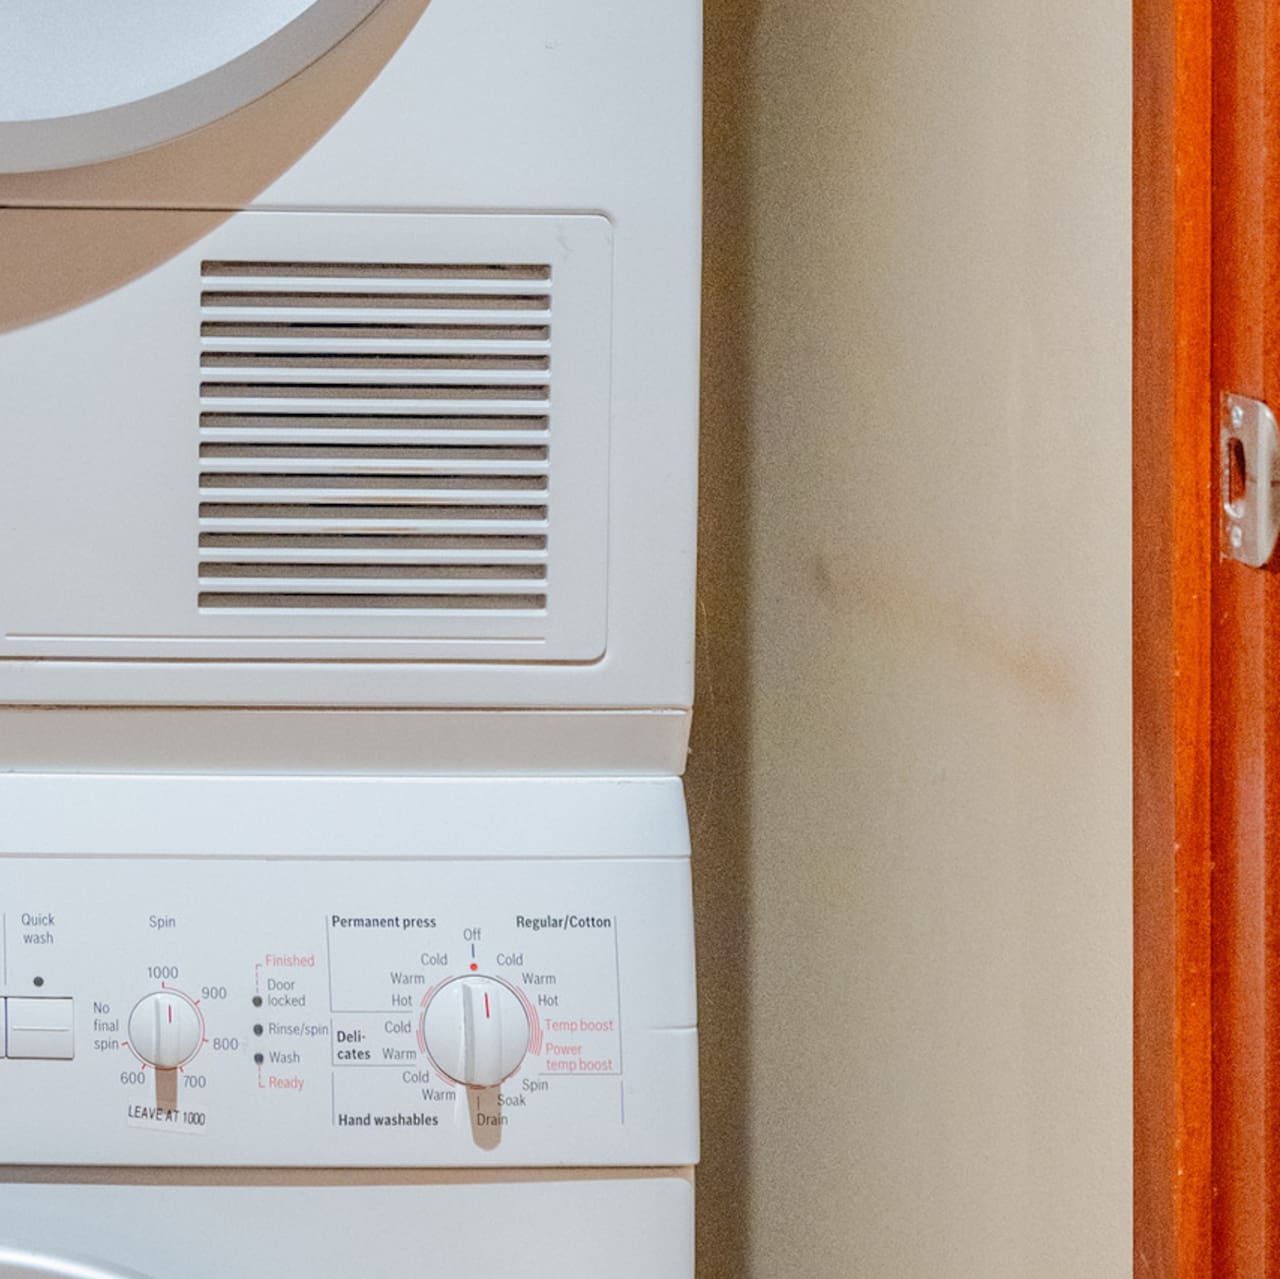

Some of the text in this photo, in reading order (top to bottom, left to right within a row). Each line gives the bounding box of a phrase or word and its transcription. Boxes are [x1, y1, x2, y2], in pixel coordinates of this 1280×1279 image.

[21, 912, 55, 927] Quick
[149, 915, 176, 930] Spin
[331, 915, 437, 930] Permanent press
[516, 915, 611, 930] Regular/Cotton
[23, 931, 54, 944] wash
[463, 928, 481, 941] Off
[265, 954, 315, 967] Finished
[420, 953, 448, 966] Cold
[496, 953, 524, 966] Cold
[147, 966, 178, 979] 1000
[390, 973, 425, 985] Warm
[521, 972, 556, 985] Warm
[267, 979, 295, 991] Door
[201, 987, 227, 999] 900
[267, 995, 306, 1007] locked
[391, 994, 413, 1007] Hot
[538, 994, 559, 1007] Hot
[93, 1002, 110, 1014] No
[94, 1019, 119, 1031] final
[268, 1023, 329, 1037] Rinse/spin
[384, 1021, 412, 1033] Cold
[545, 1019, 613, 1032] Temp boost
[336, 1030, 366, 1043] Deli-
[94, 1037, 119, 1051] spin
[213, 1038, 239, 1051] 800
[546, 1043, 583, 1055] Power
[269, 1051, 300, 1064] Wash
[337, 1048, 371, 1061] cates
[382, 1048, 417, 1060] Warm
[546, 1058, 613, 1073] temp boost
[120, 1072, 146, 1084] 600
[183, 1075, 207, 1088] 700
[268, 1076, 304, 1091] Ready
[402, 1071, 430, 1084] Cold
[522, 1079, 549, 1093] Spin
[422, 1089, 456, 1101] Warm
[497, 1094, 526, 1107] Soak
[128, 1104, 206, 1126] LEAVE AT 1000
[338, 1113, 439, 1127] Hand washables
[476, 1113, 508, 1126] Drain
